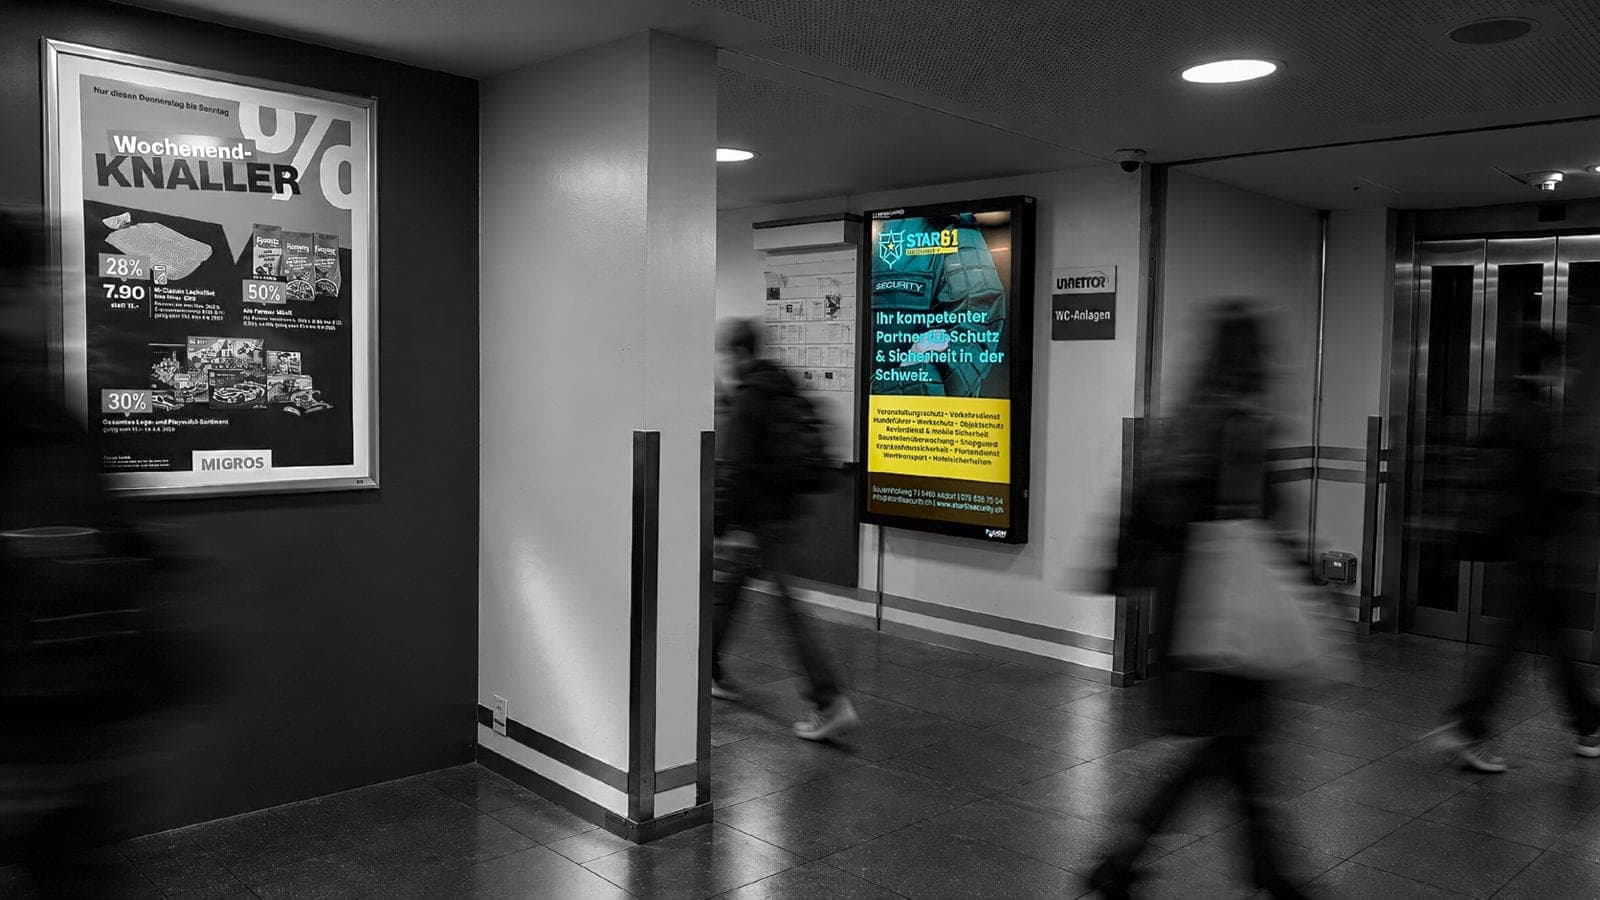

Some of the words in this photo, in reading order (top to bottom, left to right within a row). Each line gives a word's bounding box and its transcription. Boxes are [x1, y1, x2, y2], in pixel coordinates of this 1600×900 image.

[93, 86, 108, 95] Nur
[111, 89, 137, 100] diesen
[139, 93, 185, 110] Donnerstag
[186, 101, 197, 110] bis
[199, 103, 229, 117] Sonntag
[113, 135, 252, 160] Wochenend-
[95, 153, 301, 195] KNALLER
[906, 228, 959, 249] STAR61
[106, 257, 143, 277] 28%
[103, 283, 145, 300] 7.90
[248, 283, 280, 301] 50%
[875, 280, 923, 292] SECURITY
[876, 312, 894, 325] Ihr
[896, 310, 988, 328] kompetenter
[1055, 309, 1111, 322] WC-Anlagen
[876, 330, 924, 343] Partner
[950, 330, 1000, 343] Schutz
[875, 350, 886, 362] &
[888, 349, 957, 363] Sicherheit
[959, 349, 973, 362] in
[979, 349, 1005, 363] der
[875, 368, 933, 382] Schweiz.
[107, 392, 146, 411] 30%
[873, 416, 912, 424] Hundeführer
[917, 419, 954, 427] Werkschutz
[960, 420, 1004, 429] Objektschutz
[949, 411, 1001, 420] Verkehrsdienst
[886, 426, 925, 434] Revierdienst
[201, 456, 265, 472] MIGROS
